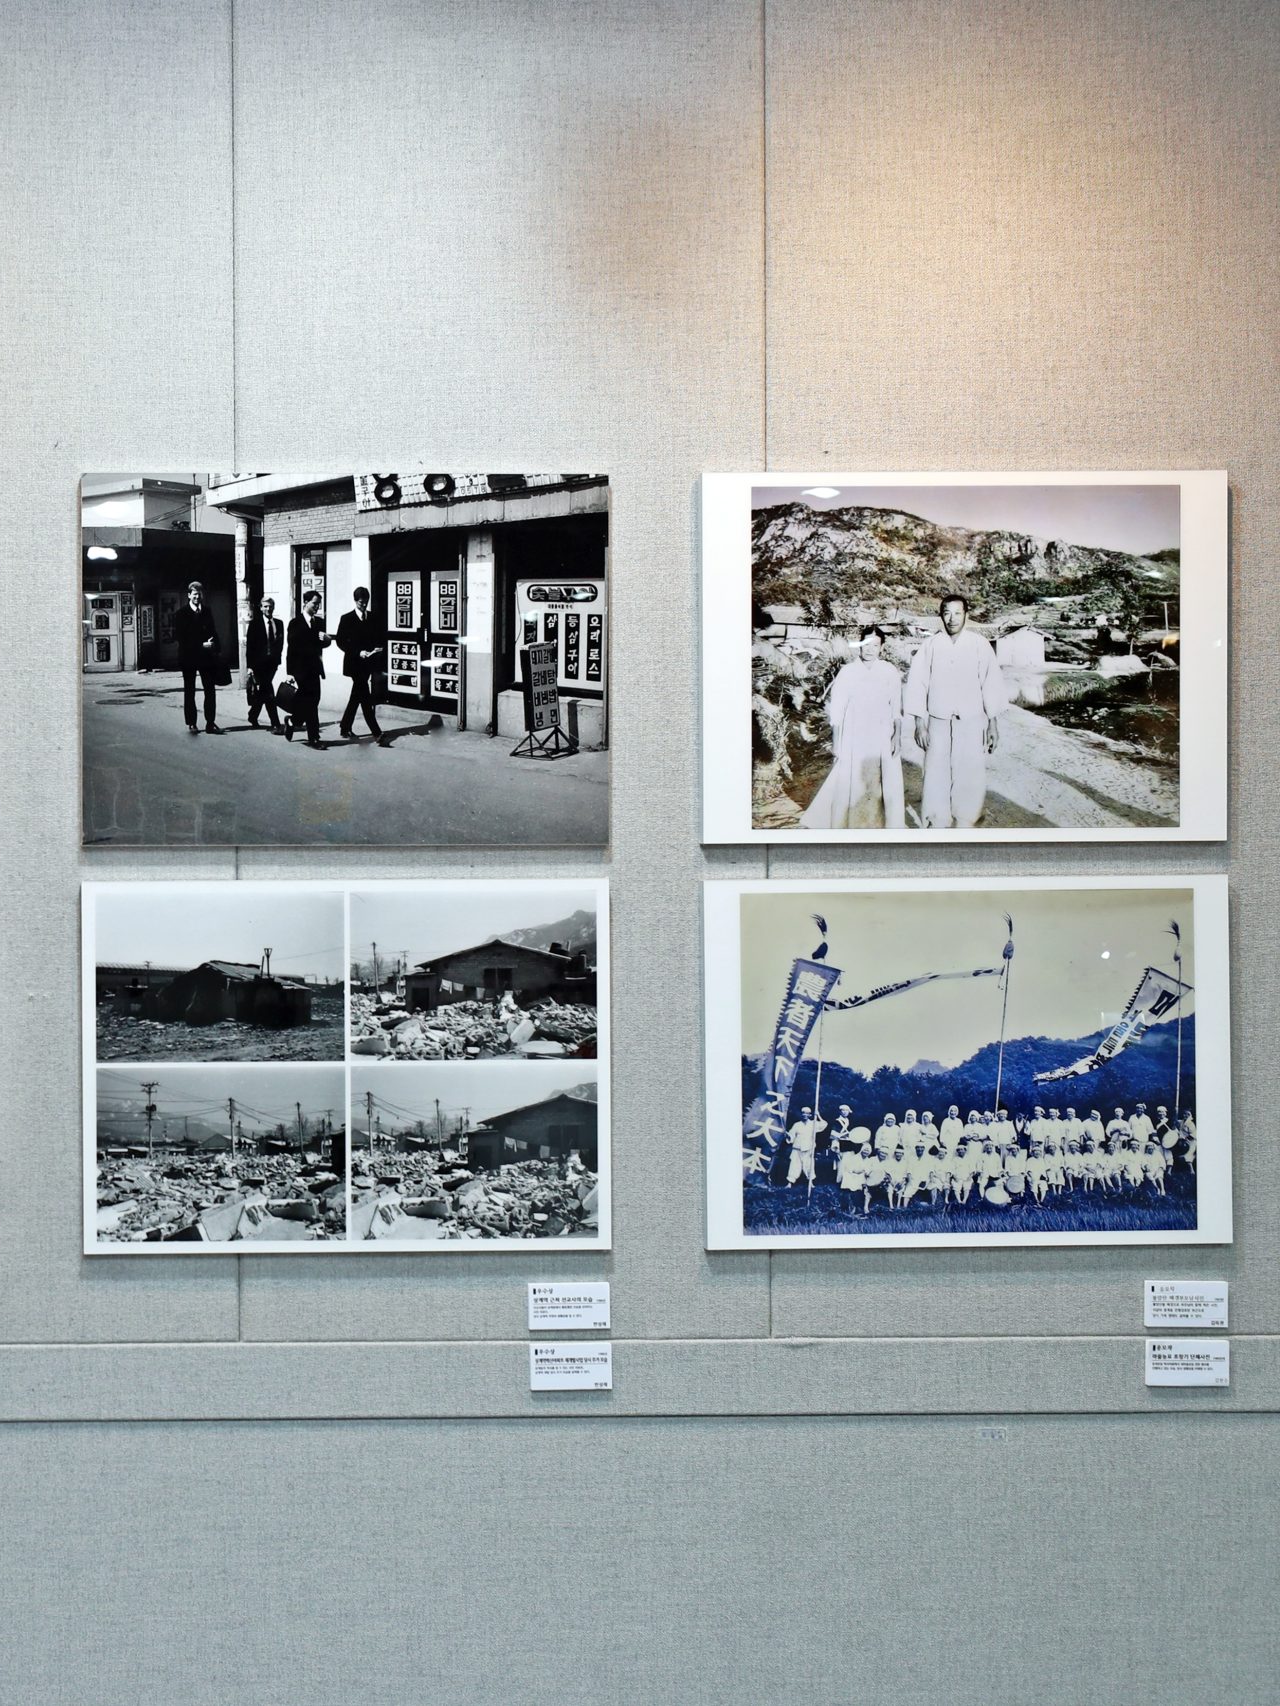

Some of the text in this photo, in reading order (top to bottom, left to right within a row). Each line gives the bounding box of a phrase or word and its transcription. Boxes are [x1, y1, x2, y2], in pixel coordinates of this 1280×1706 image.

[397, 584, 412, 595] 88
[440, 584, 457, 595] 88
[566, 615, 579, 675] 등심구이
[587, 616, 600, 675] 오리로스
